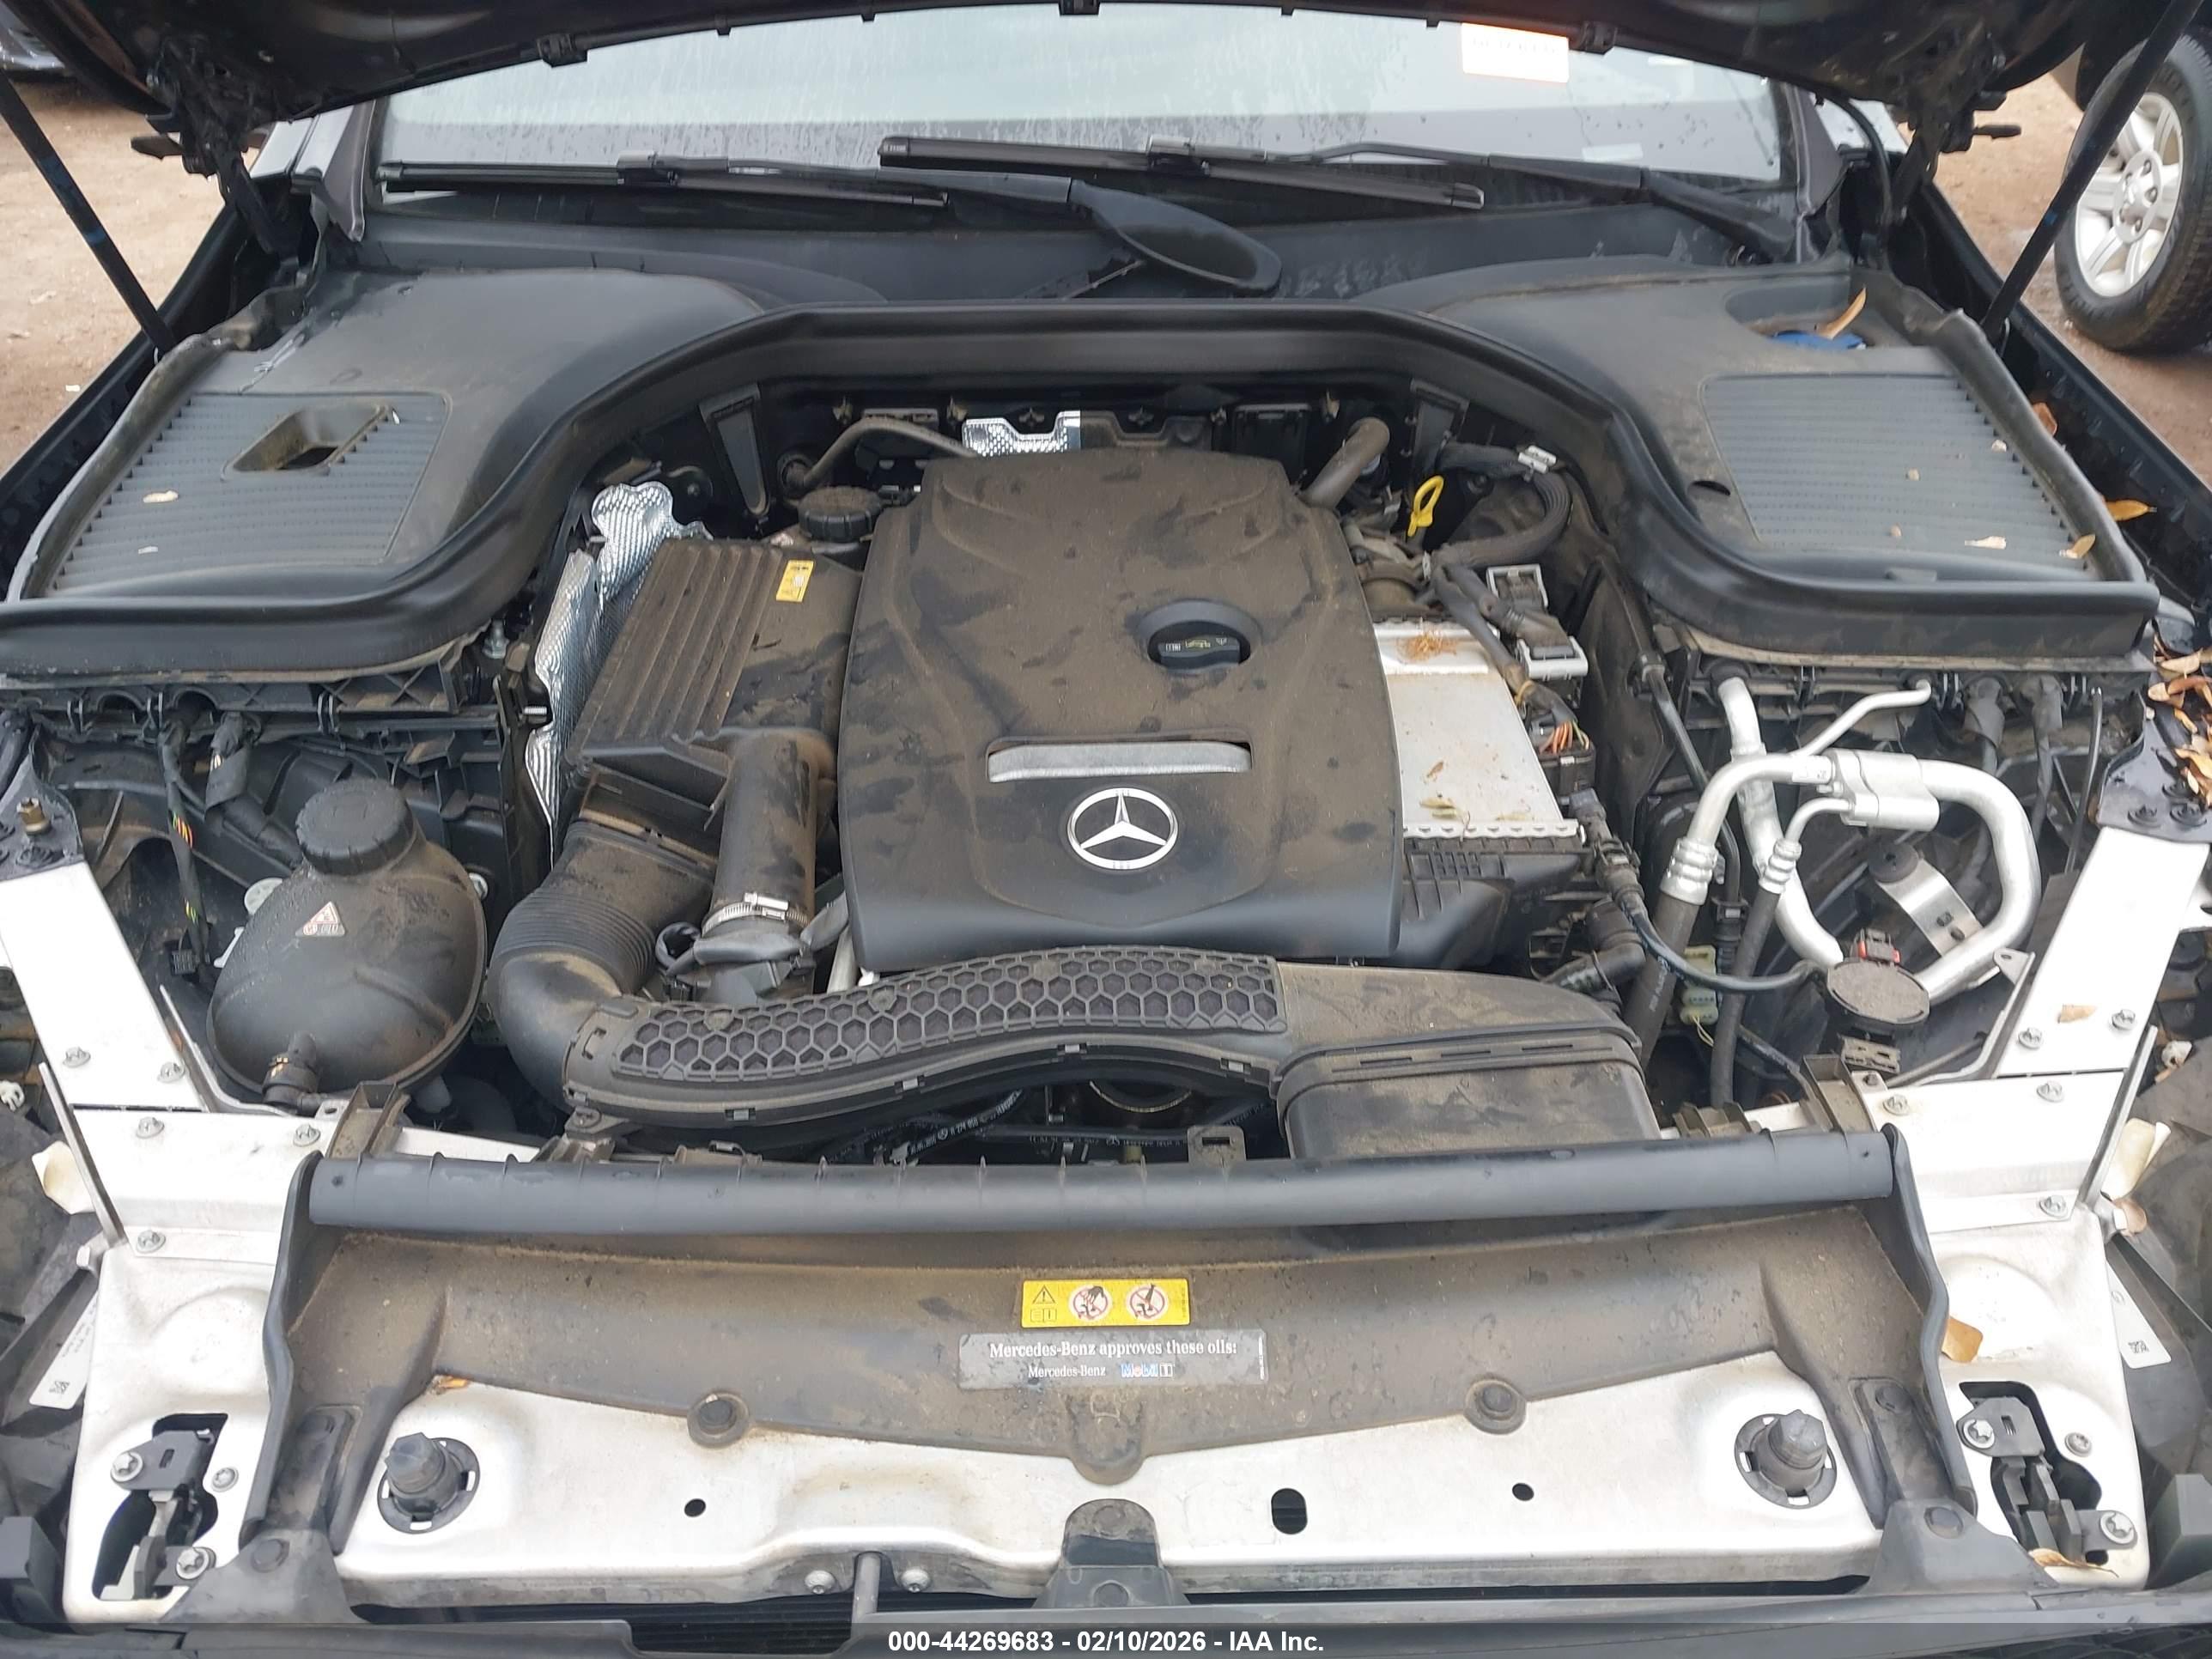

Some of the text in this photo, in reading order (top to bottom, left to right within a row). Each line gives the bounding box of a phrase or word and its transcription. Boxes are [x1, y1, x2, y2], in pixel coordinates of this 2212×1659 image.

[989, 1339, 1237, 1358] Mercedes-Benz approves these oils:
[1028, 1364, 1107, 1378] Mercedes-Benz
[1121, 1362, 1158, 1377] Mobil
